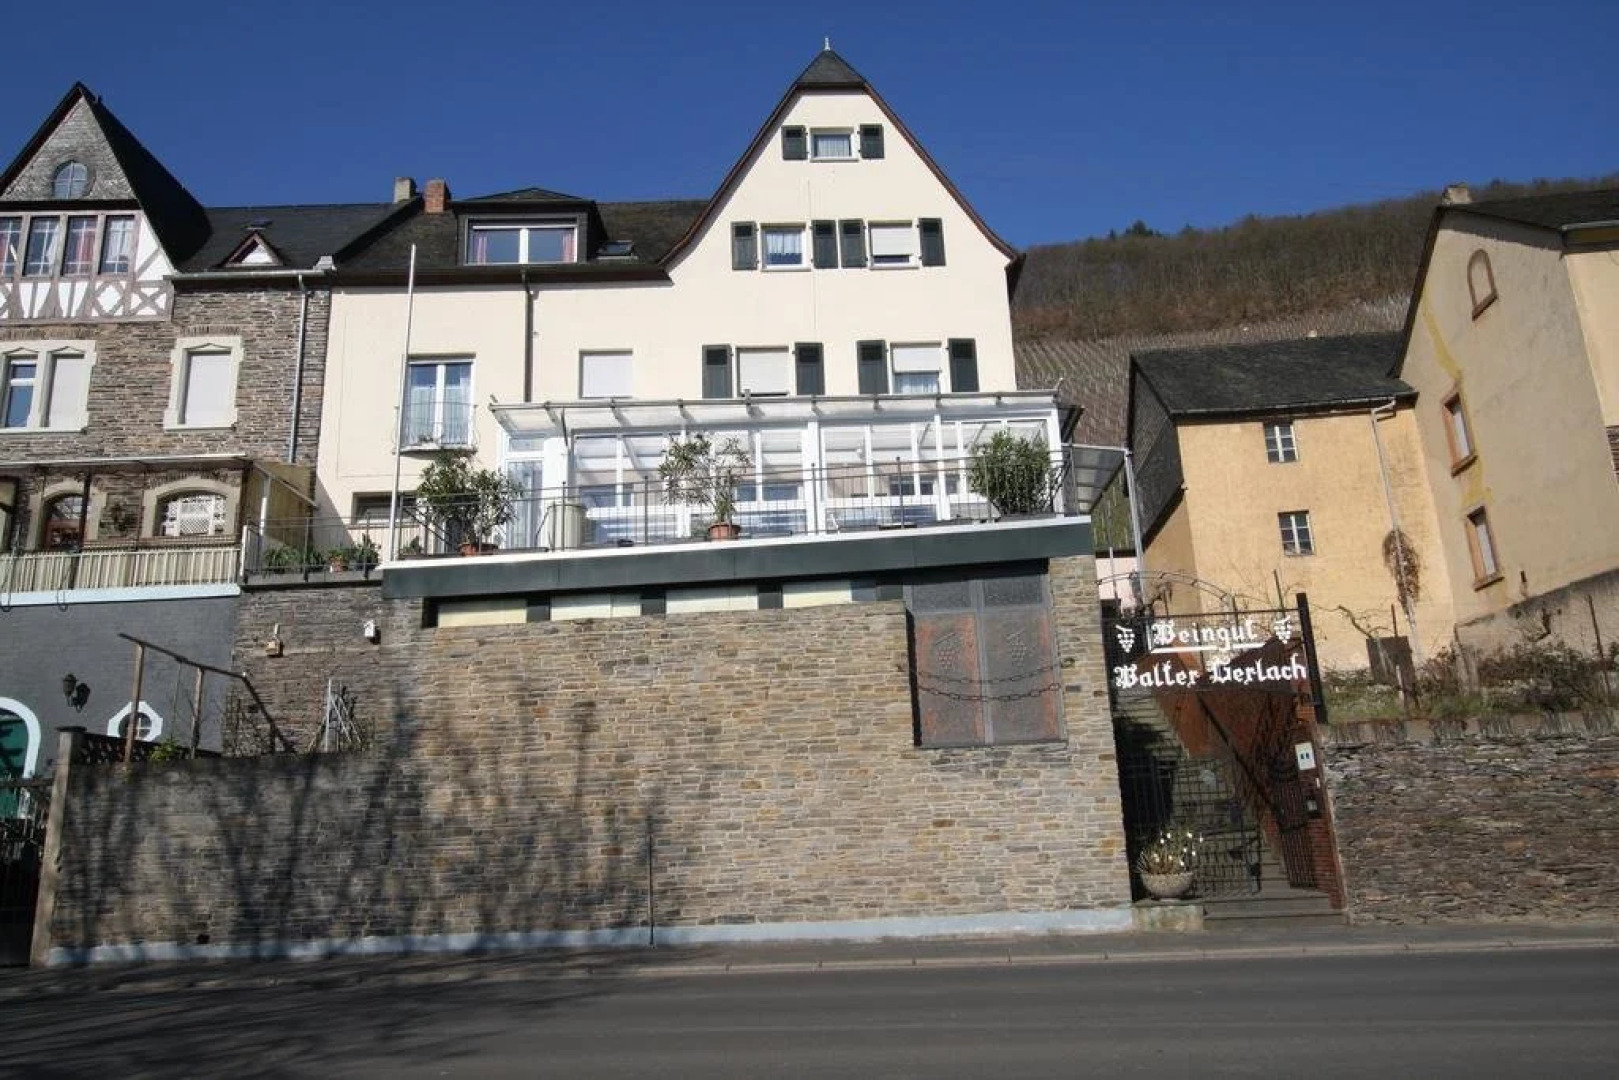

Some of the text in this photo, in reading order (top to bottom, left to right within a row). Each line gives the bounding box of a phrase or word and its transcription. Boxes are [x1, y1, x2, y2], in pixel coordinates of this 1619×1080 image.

[1151, 615, 1258, 651] Weingut
[1113, 652, 1307, 689] Walter Gerlach
